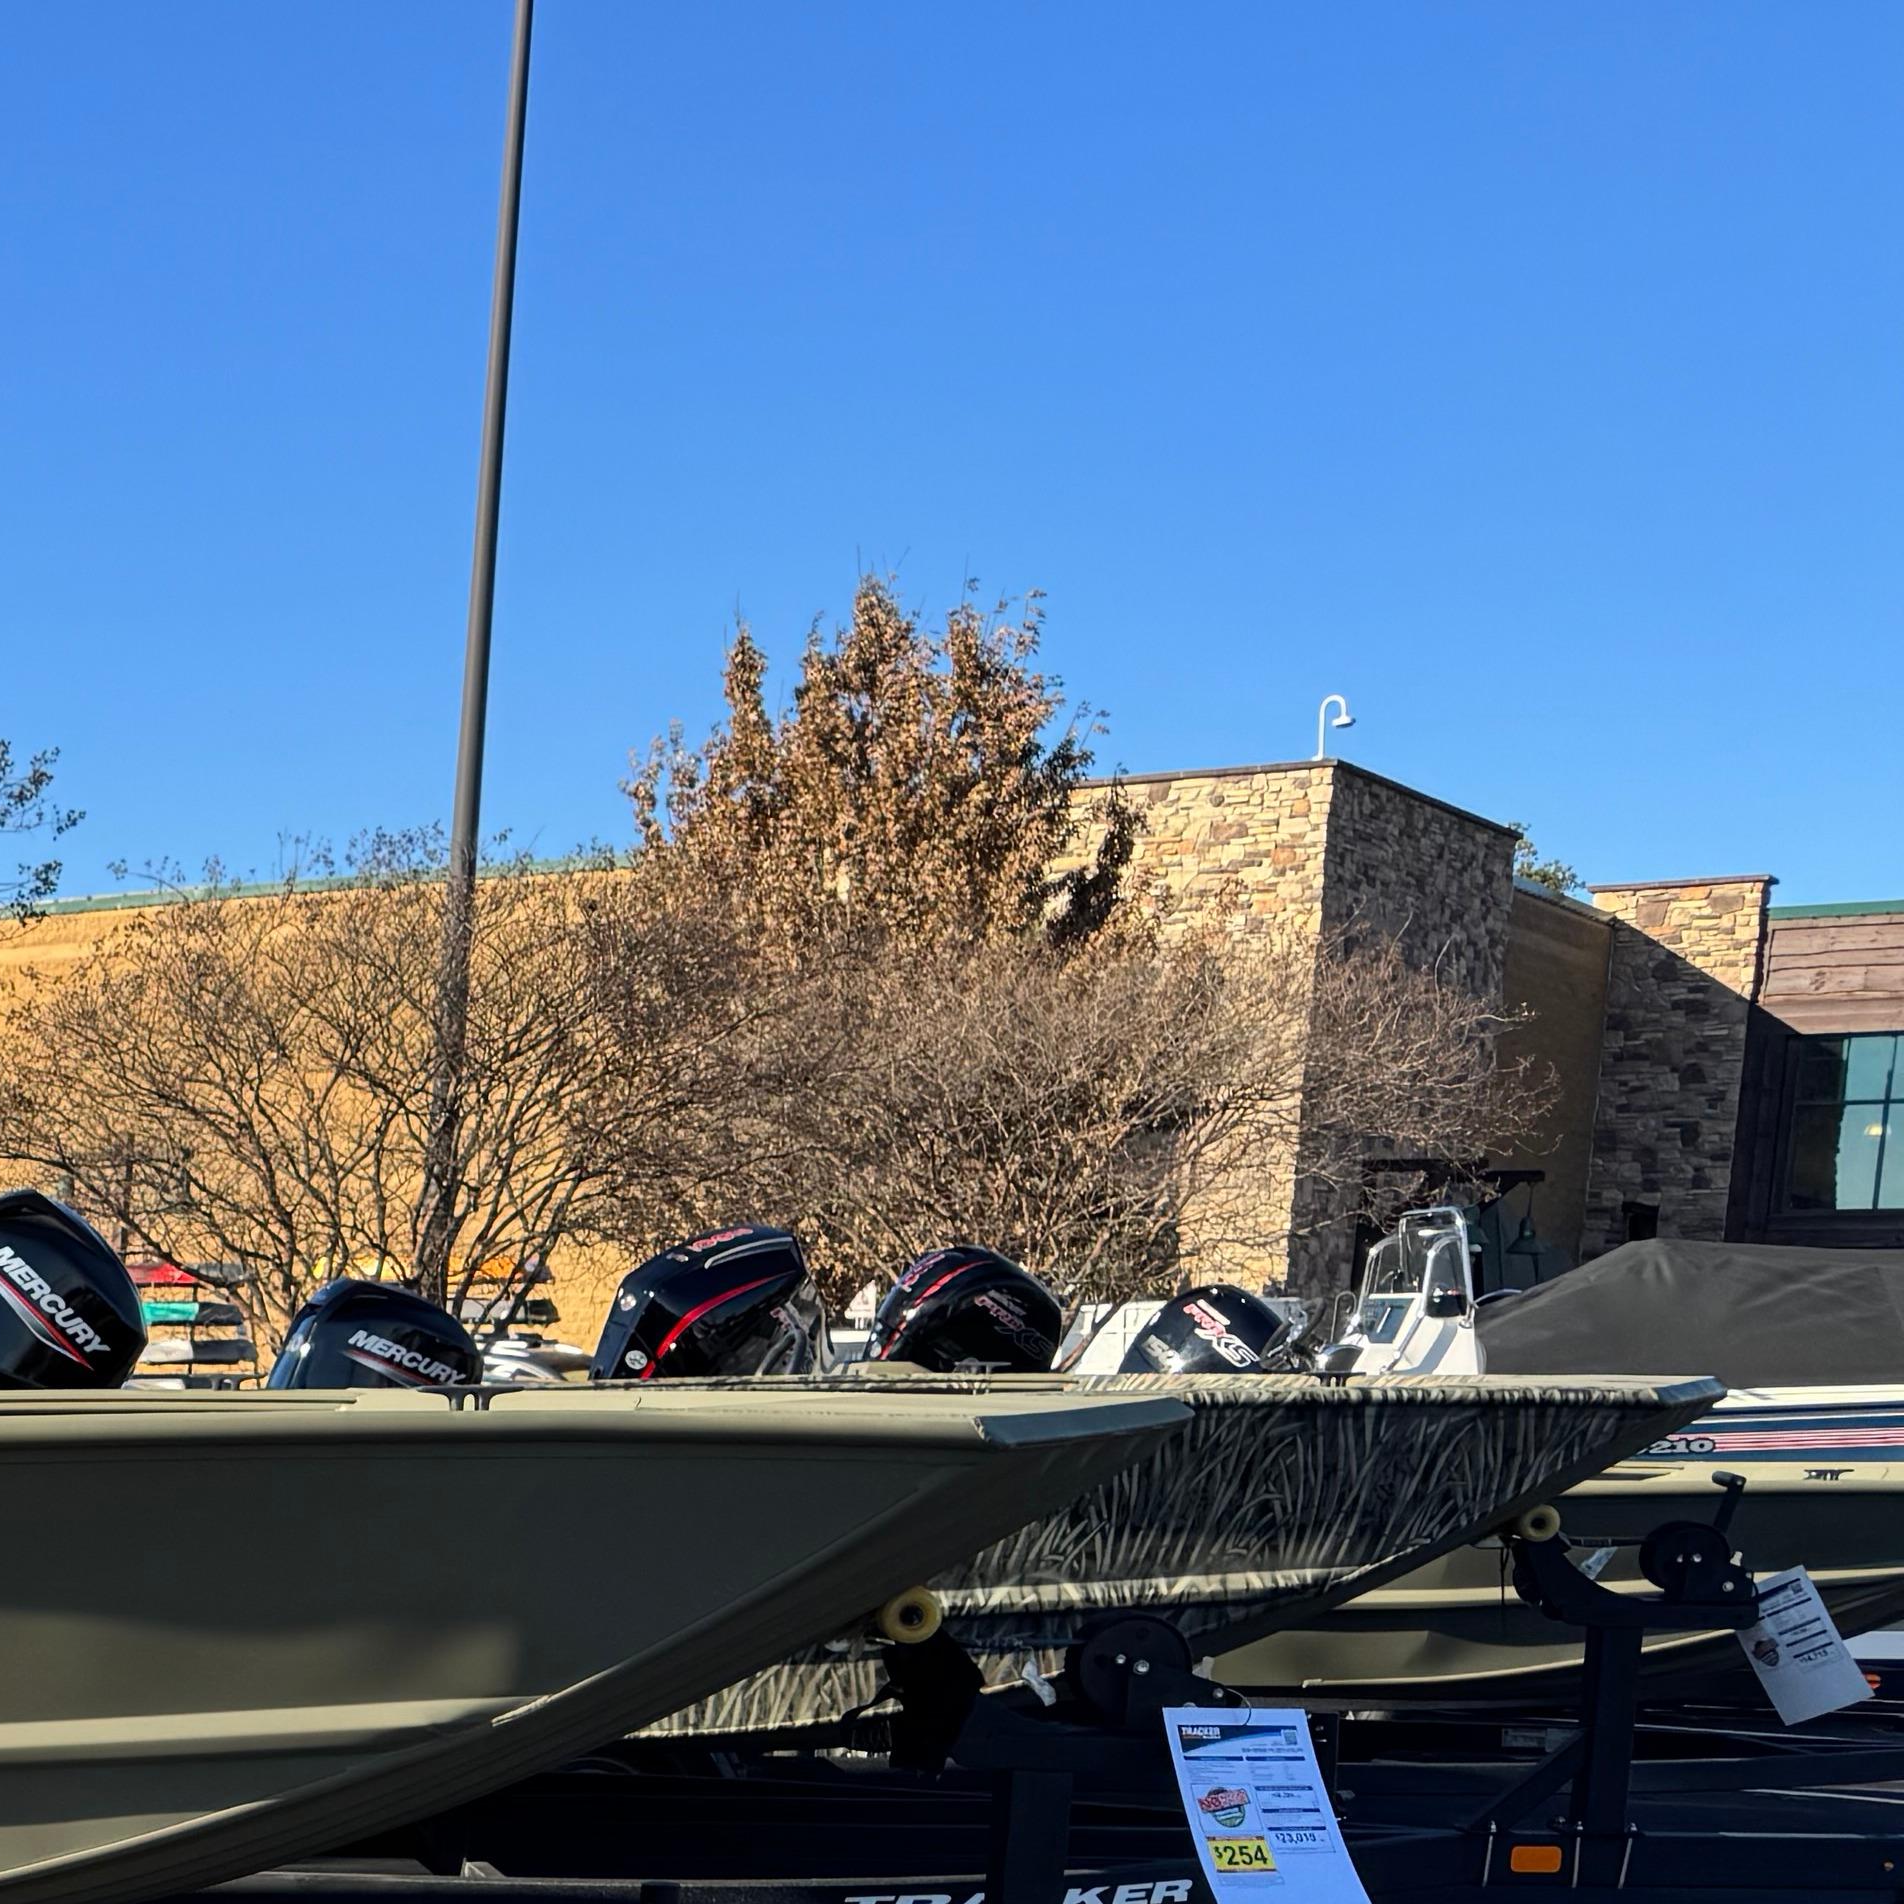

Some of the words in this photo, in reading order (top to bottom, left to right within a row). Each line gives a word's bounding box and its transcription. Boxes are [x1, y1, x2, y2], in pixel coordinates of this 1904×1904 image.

[348, 1330, 467, 1385] MERCURY
[1181, 1727, 1221, 1736] TRACKER
[1214, 1845, 1268, 1865] $254
